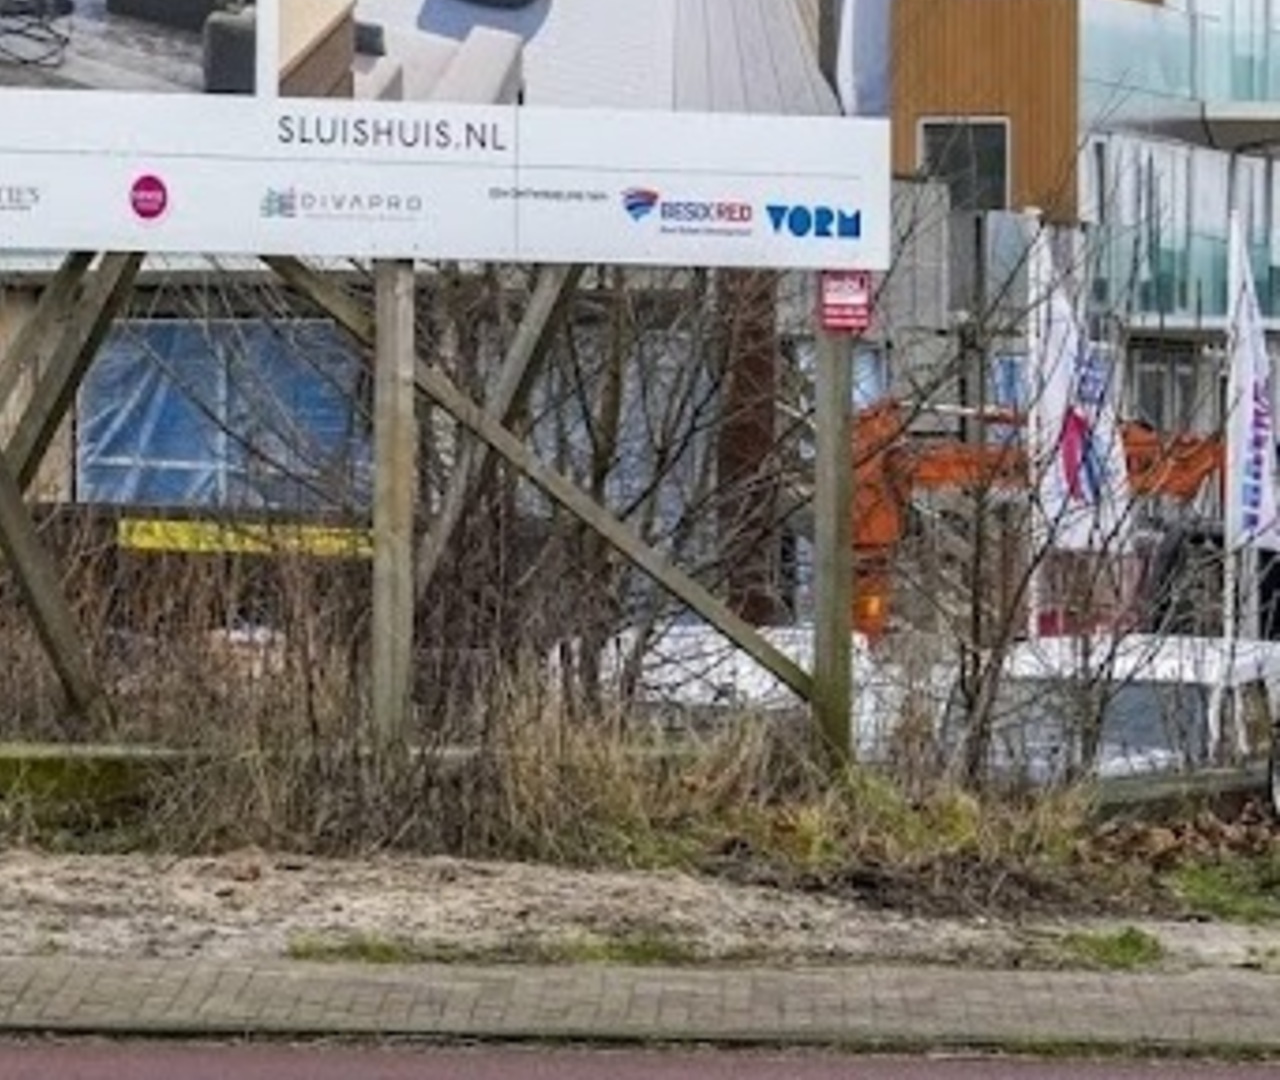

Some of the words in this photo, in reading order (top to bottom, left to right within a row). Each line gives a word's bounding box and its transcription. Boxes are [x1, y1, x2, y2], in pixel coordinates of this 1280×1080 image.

[277, 115, 507, 151] SLUISHUIS.NL
[300, 192, 423, 211] DIVAPRO
[716, 202, 752, 223] RED
[766, 204, 862, 238] VORM
